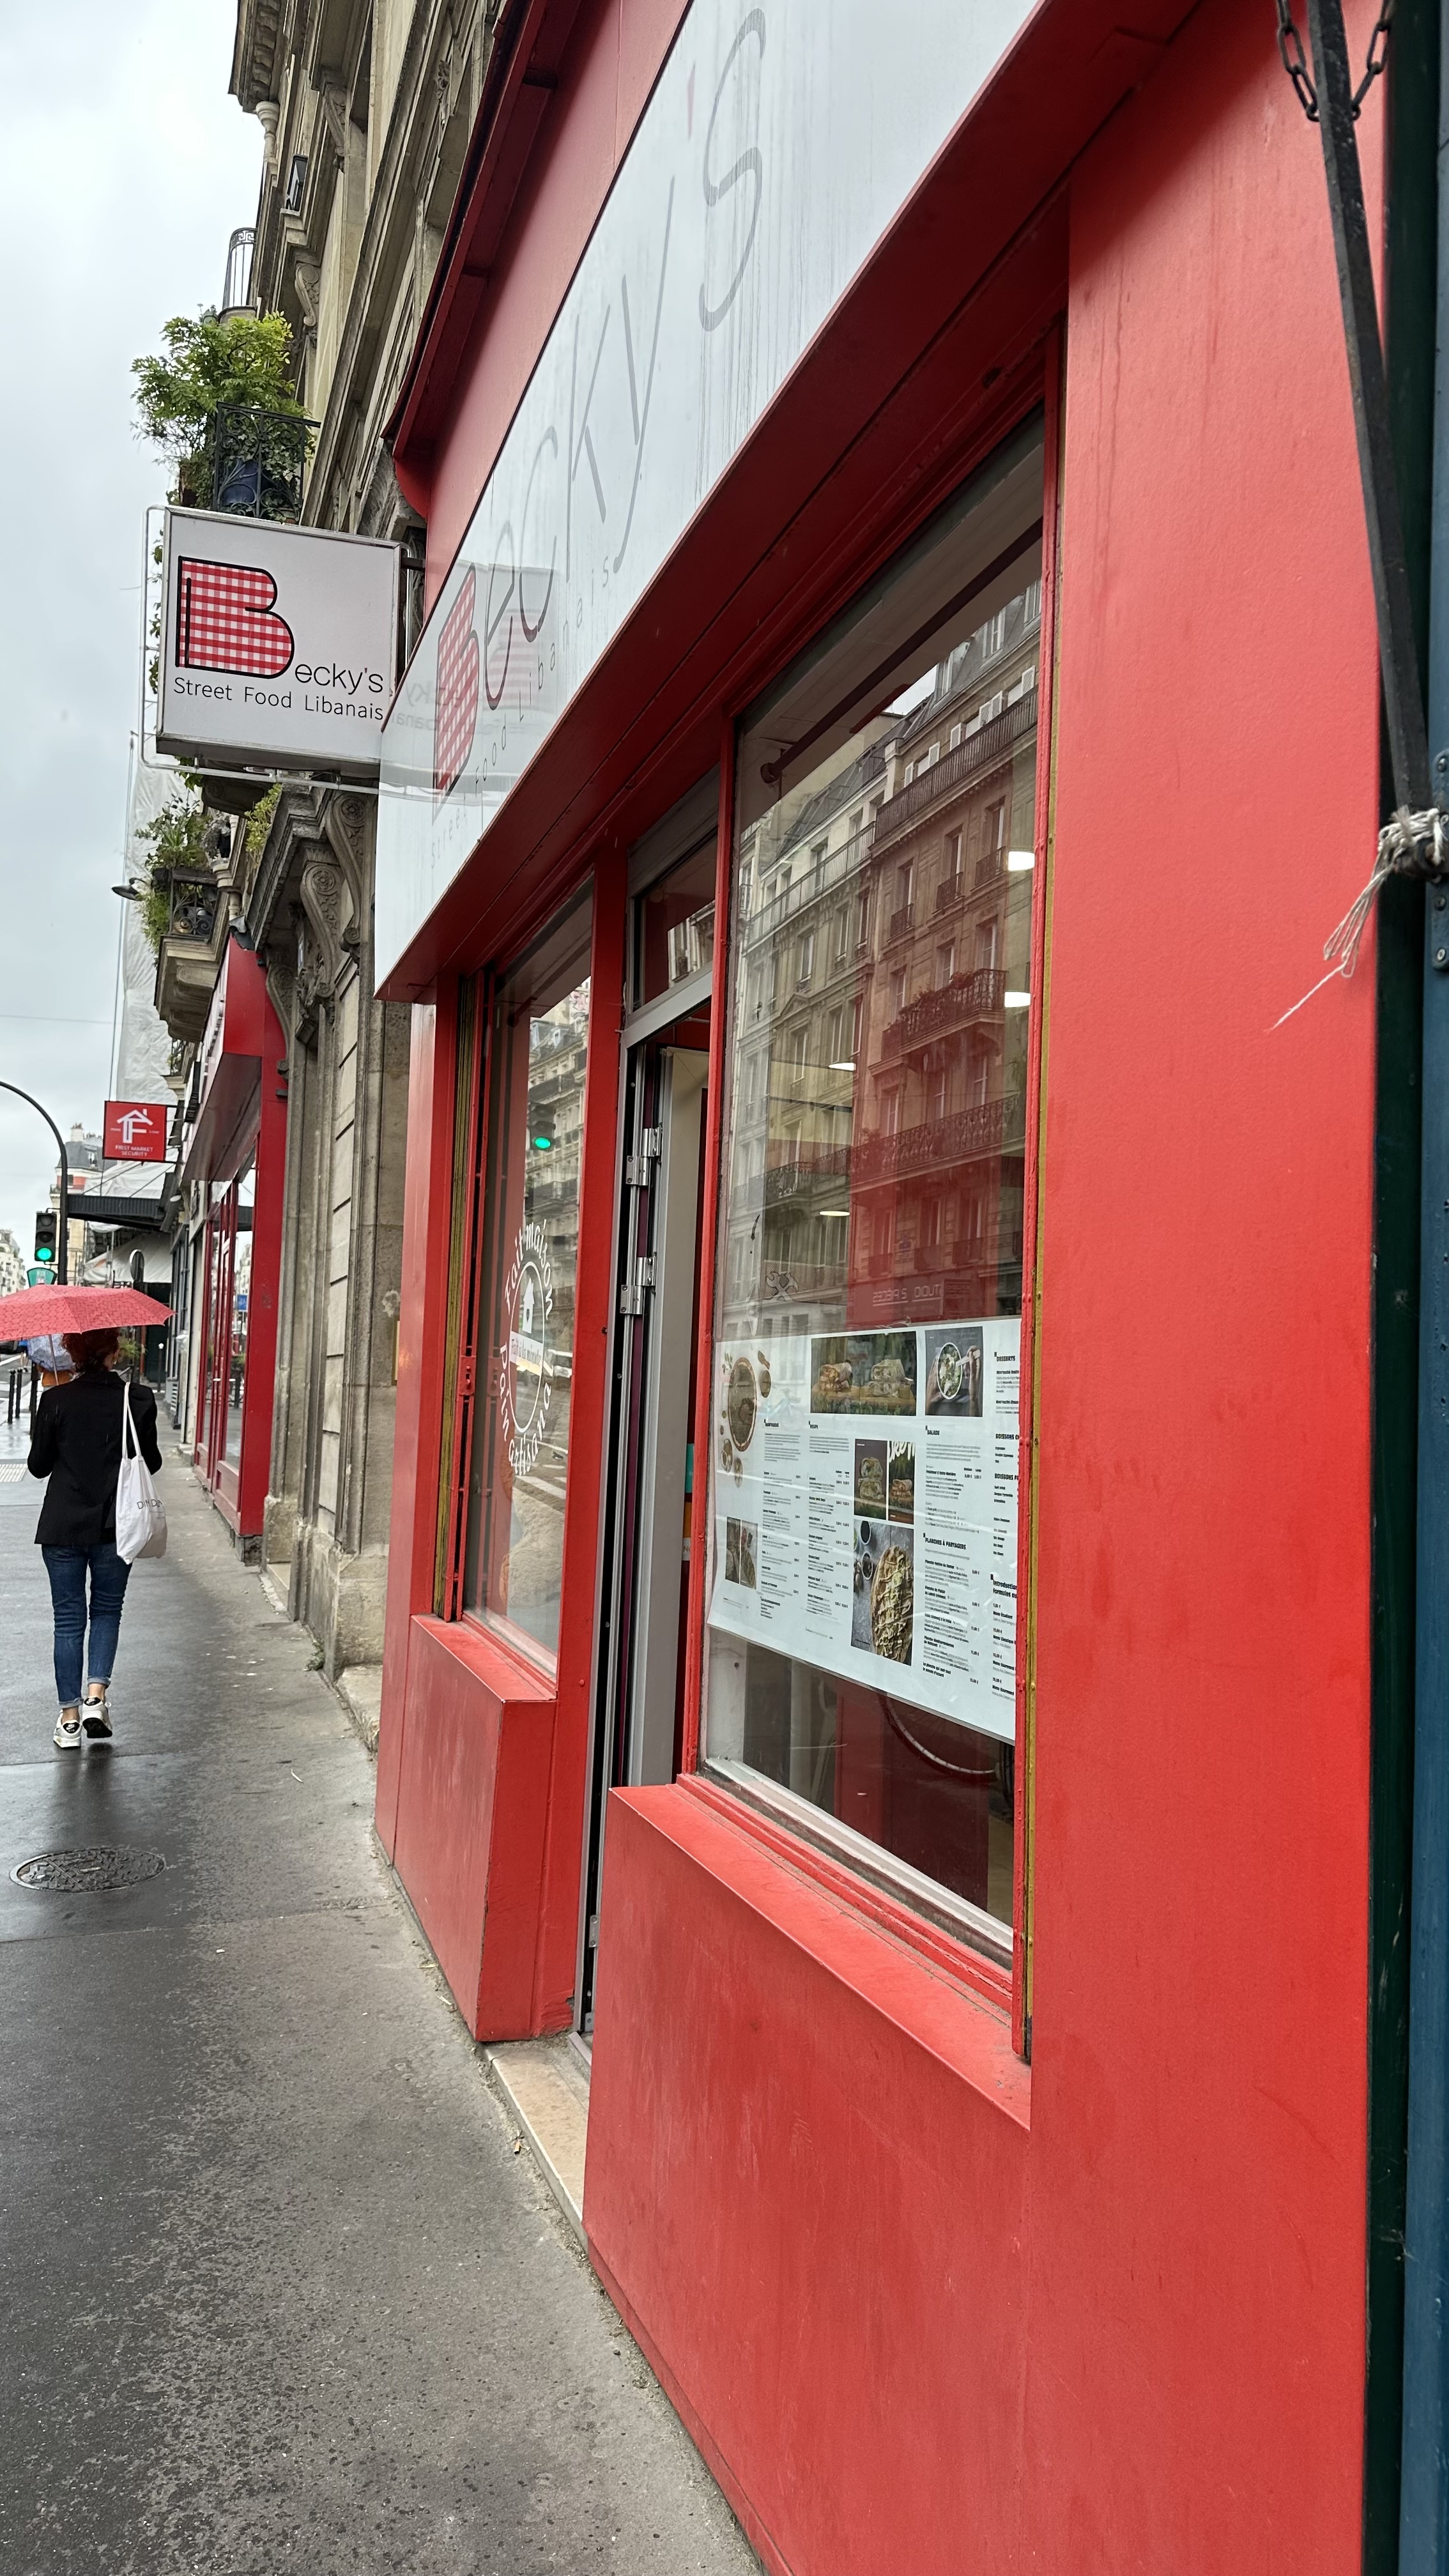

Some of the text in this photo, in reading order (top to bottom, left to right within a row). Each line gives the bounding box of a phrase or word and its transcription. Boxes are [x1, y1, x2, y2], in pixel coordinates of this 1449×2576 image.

[174, 555, 384, 695] Becky's
[173, 677, 233, 702] Street
[244, 686, 292, 709] Food
[304, 694, 384, 721] Libanais
[475, 714, 507, 798] Food
[505, 1218, 553, 1320] Fait maison
